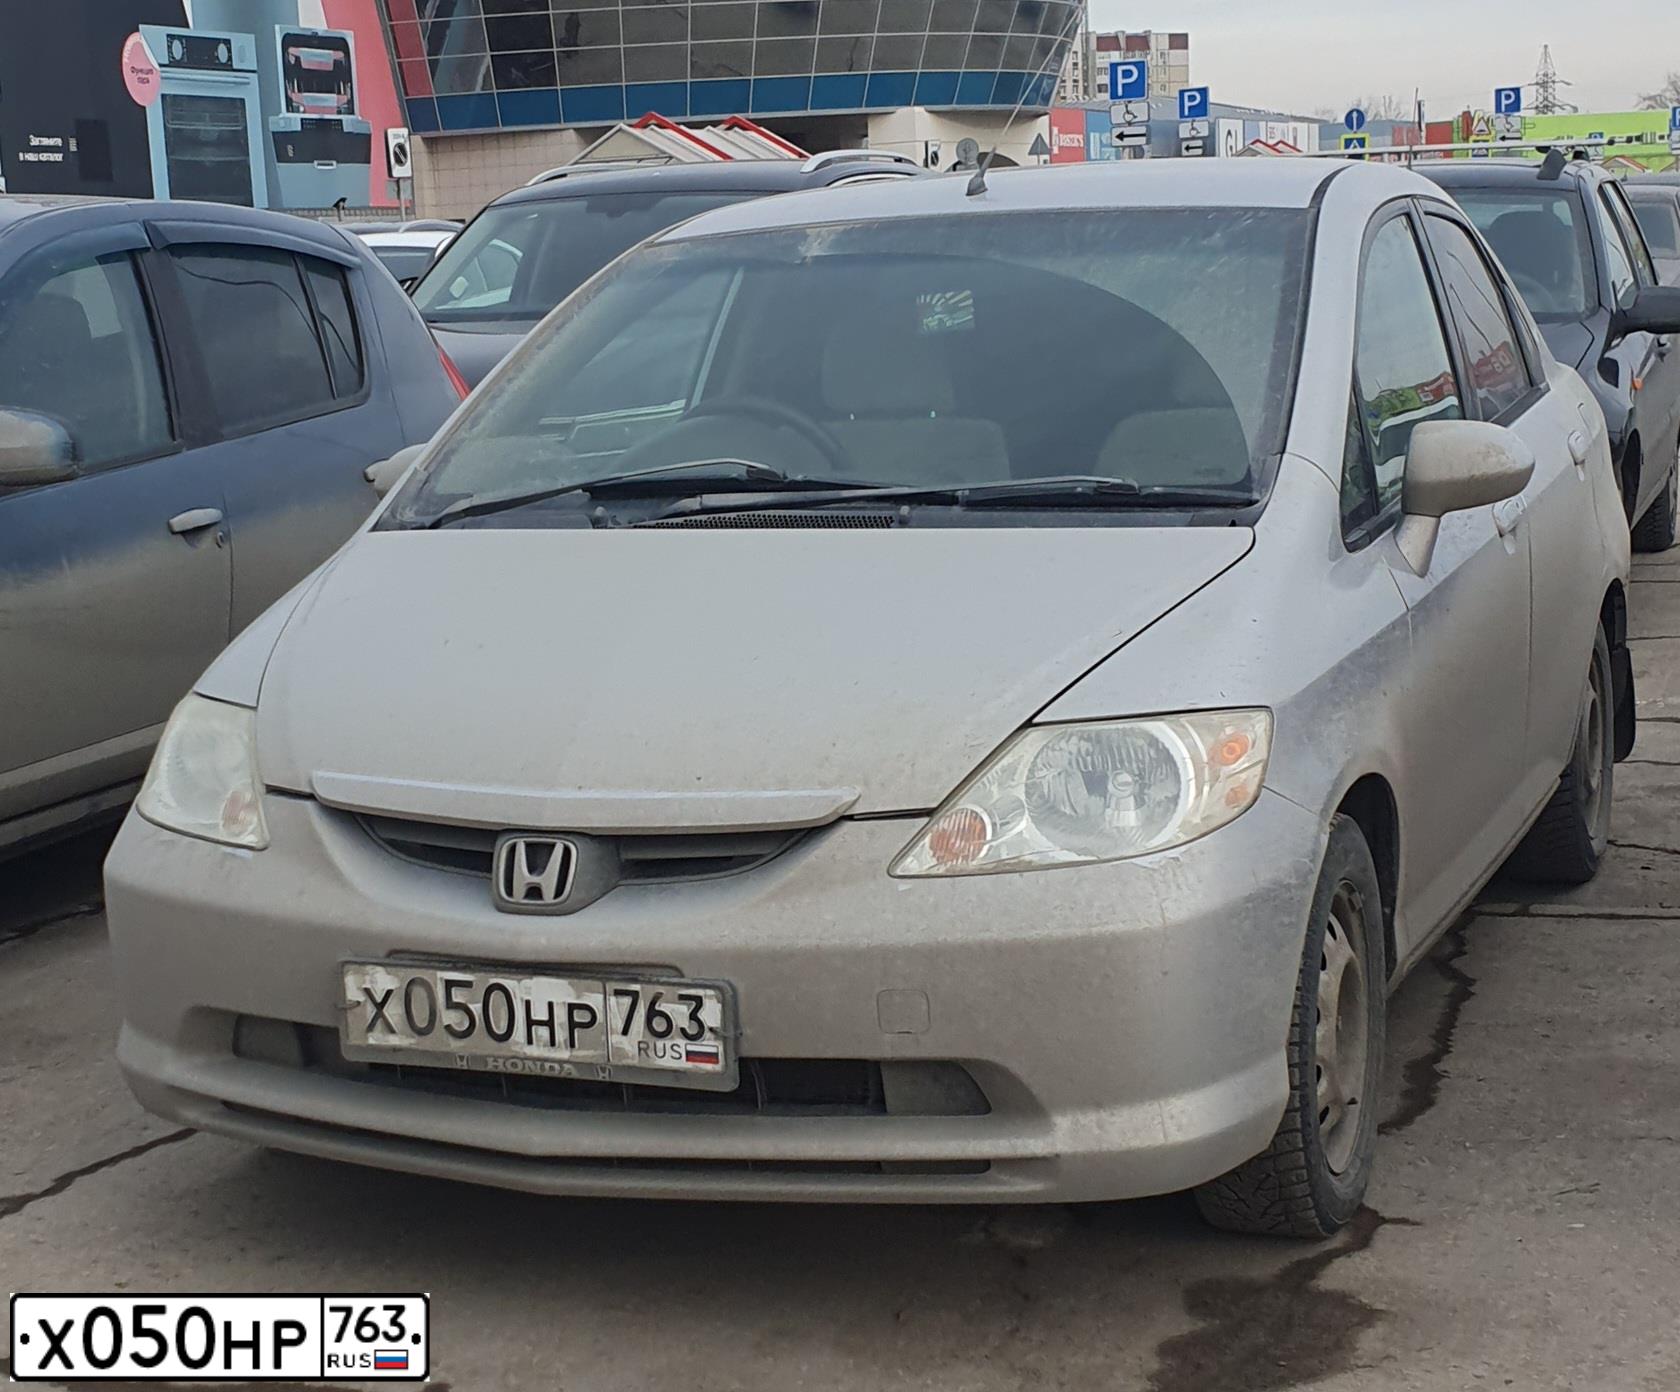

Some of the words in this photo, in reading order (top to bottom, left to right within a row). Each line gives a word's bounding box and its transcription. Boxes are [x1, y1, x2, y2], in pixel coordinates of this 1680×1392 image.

[1117, 65, 1139, 97] P
[1184, 91, 1201, 116] P
[1501, 90, 1516, 112] P
[613, 989, 706, 1042] 763
[637, 1041, 682, 1061] RUS
[486, 1057, 579, 1077] HONDA
